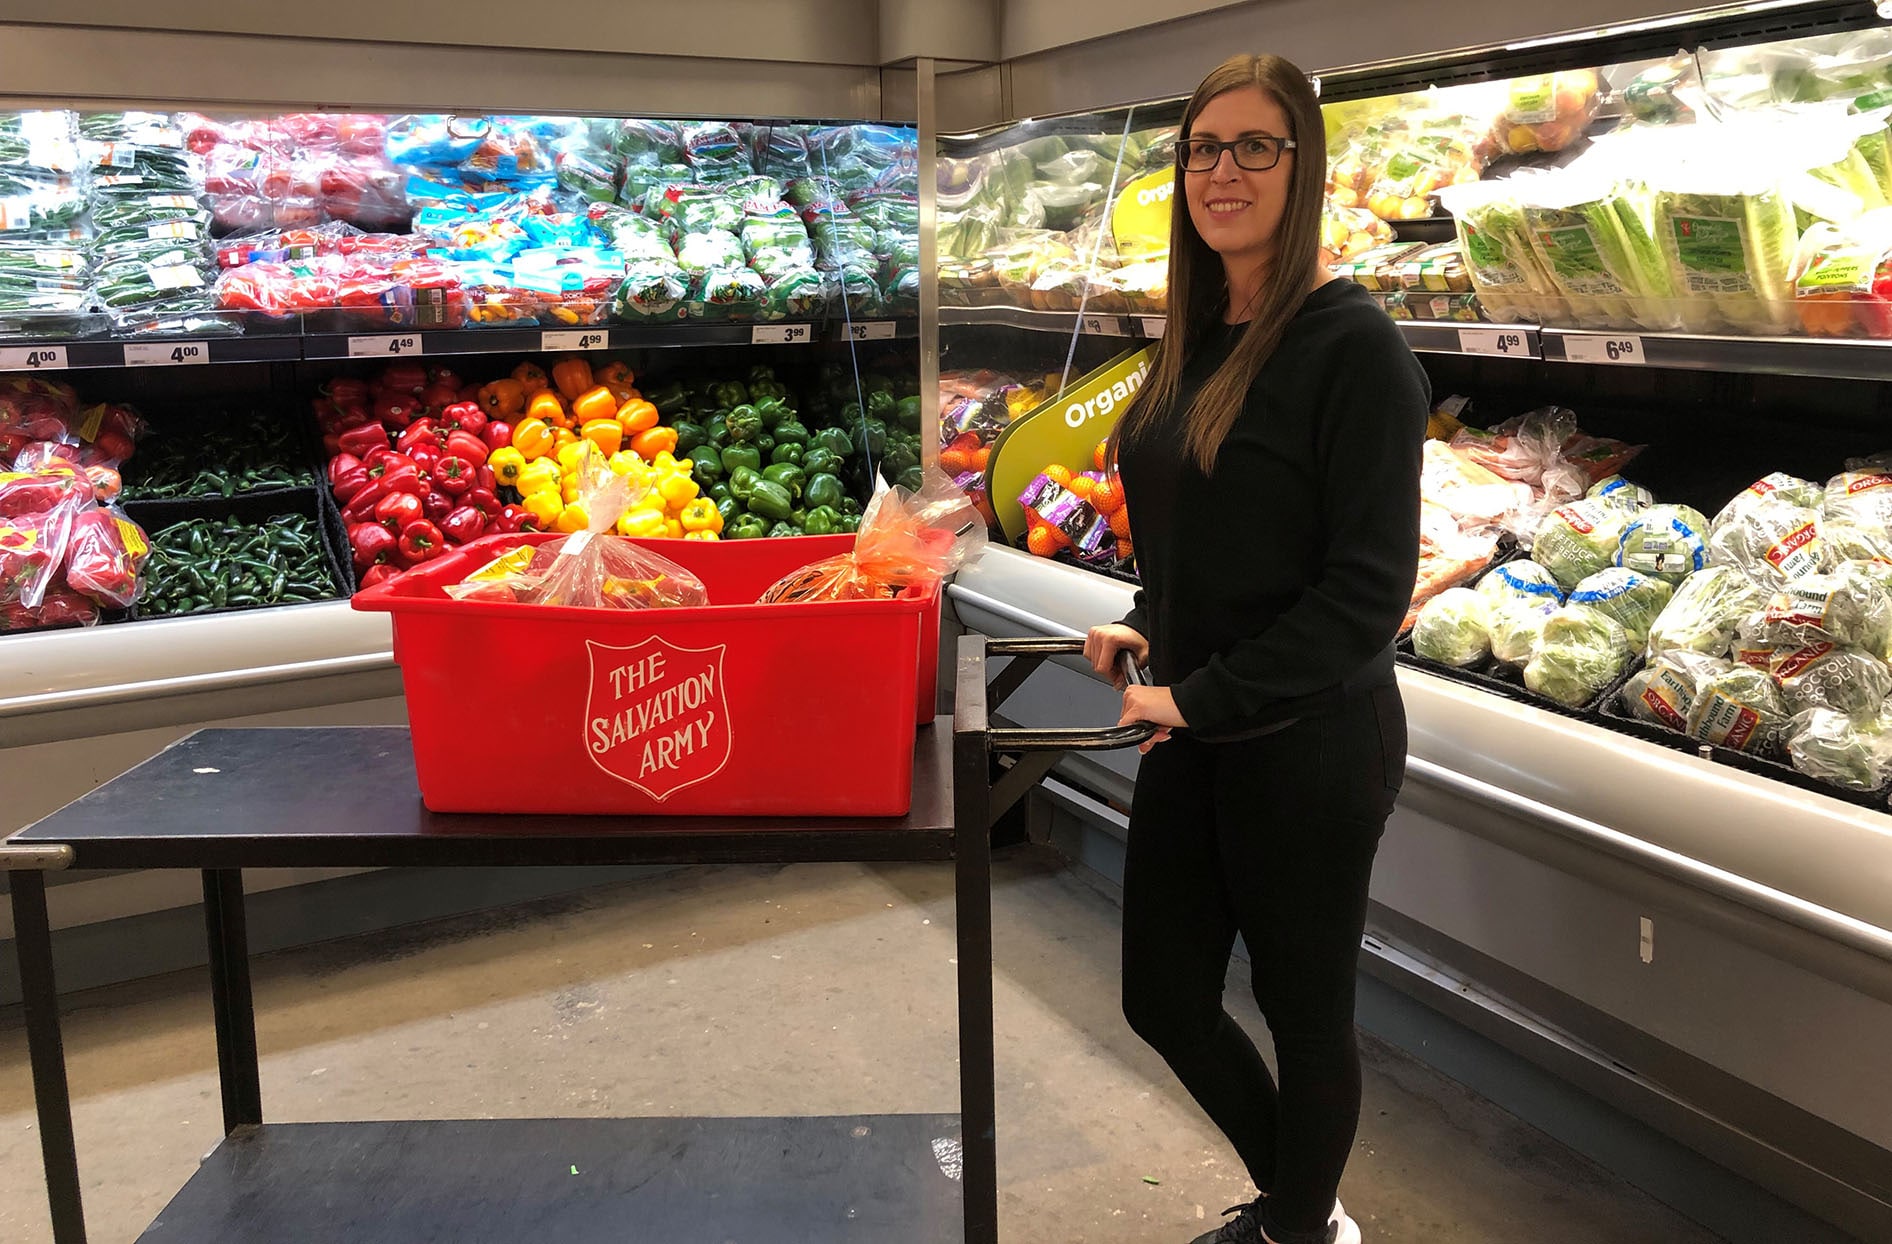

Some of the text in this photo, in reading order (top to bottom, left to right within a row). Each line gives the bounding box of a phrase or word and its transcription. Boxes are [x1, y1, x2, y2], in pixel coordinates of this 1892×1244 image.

[578, 335, 602, 349] 499
[784, 328, 805, 342] 399
[1496, 334, 1520, 353] 499
[170, 346, 199, 363] 400
[388, 338, 414, 354] 449
[1606, 340, 1633, 360] 649
[26, 351, 57, 368] 400
[1064, 361, 1153, 428] Organi
[1553, 531, 1595, 563] LETTUCE
[609, 651, 667, 700] THE
[591, 664, 715, 754] SALVATION
[1717, 703, 1737, 728] Farm
[638, 710, 715, 779] ARMY
